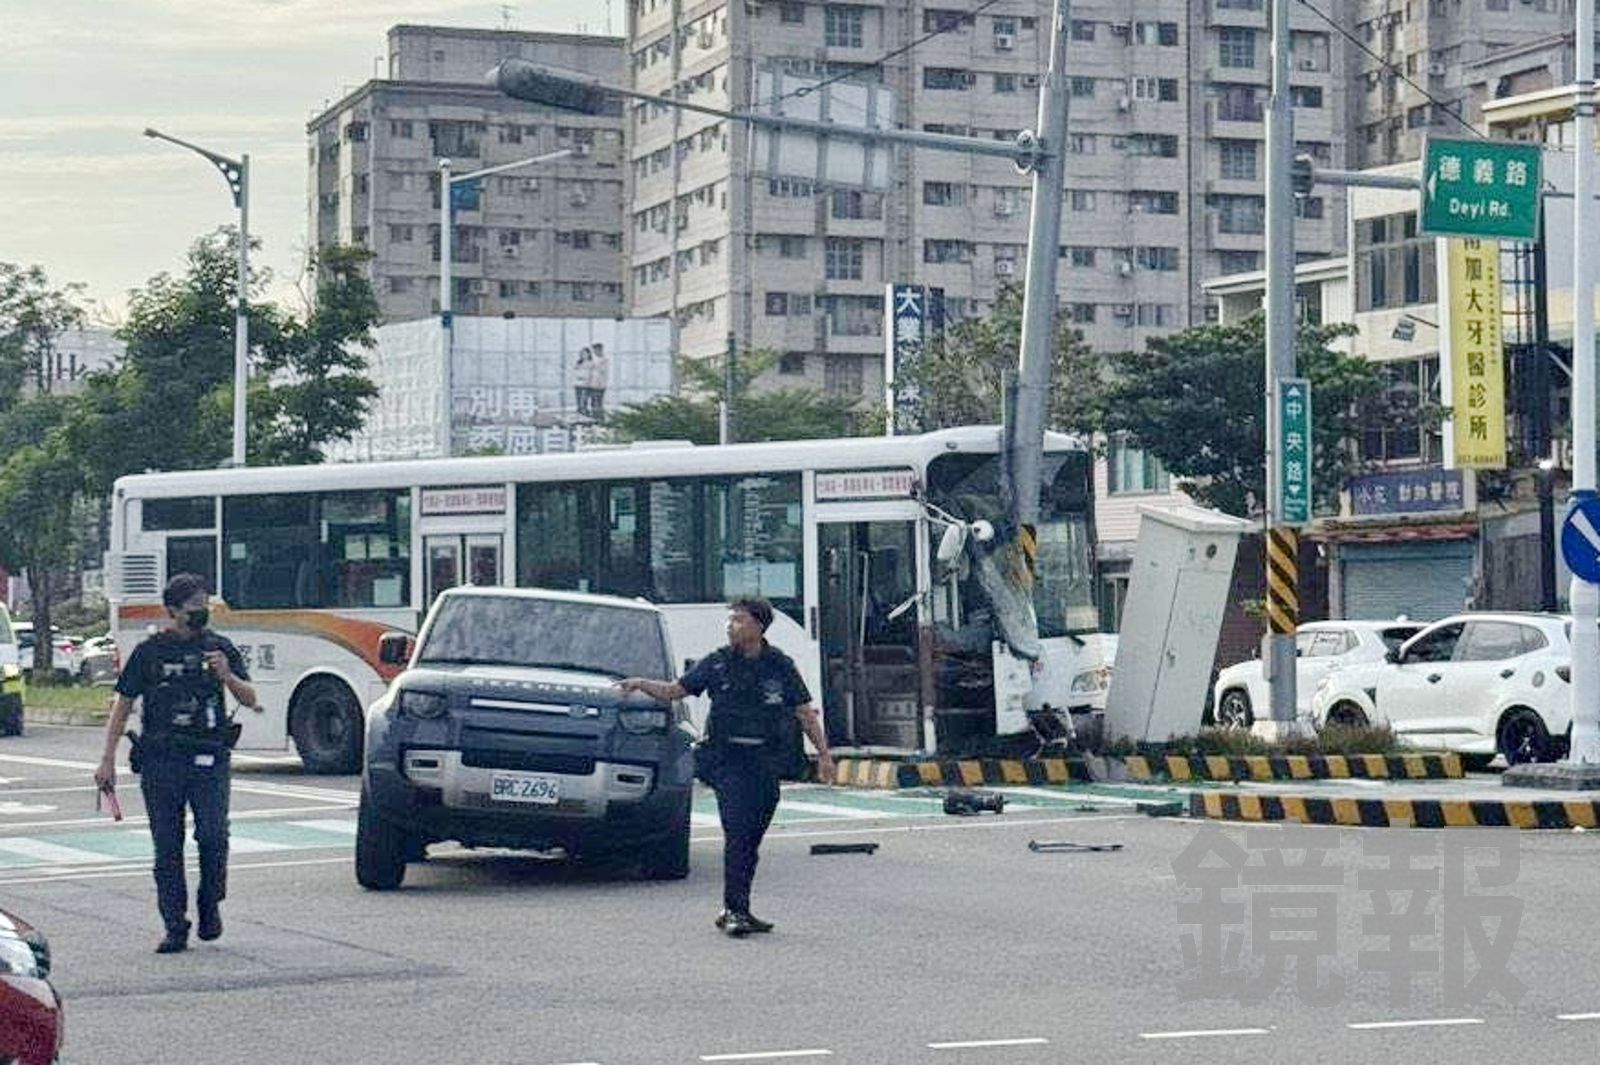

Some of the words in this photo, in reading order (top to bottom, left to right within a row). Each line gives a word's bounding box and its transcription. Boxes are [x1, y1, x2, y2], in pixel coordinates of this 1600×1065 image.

[1438, 154, 1527, 187] 德義路
[1448, 197, 1486, 220] Deyi
[469, 386, 538, 422] 別再
[1285, 400, 1304, 482] 中央路
